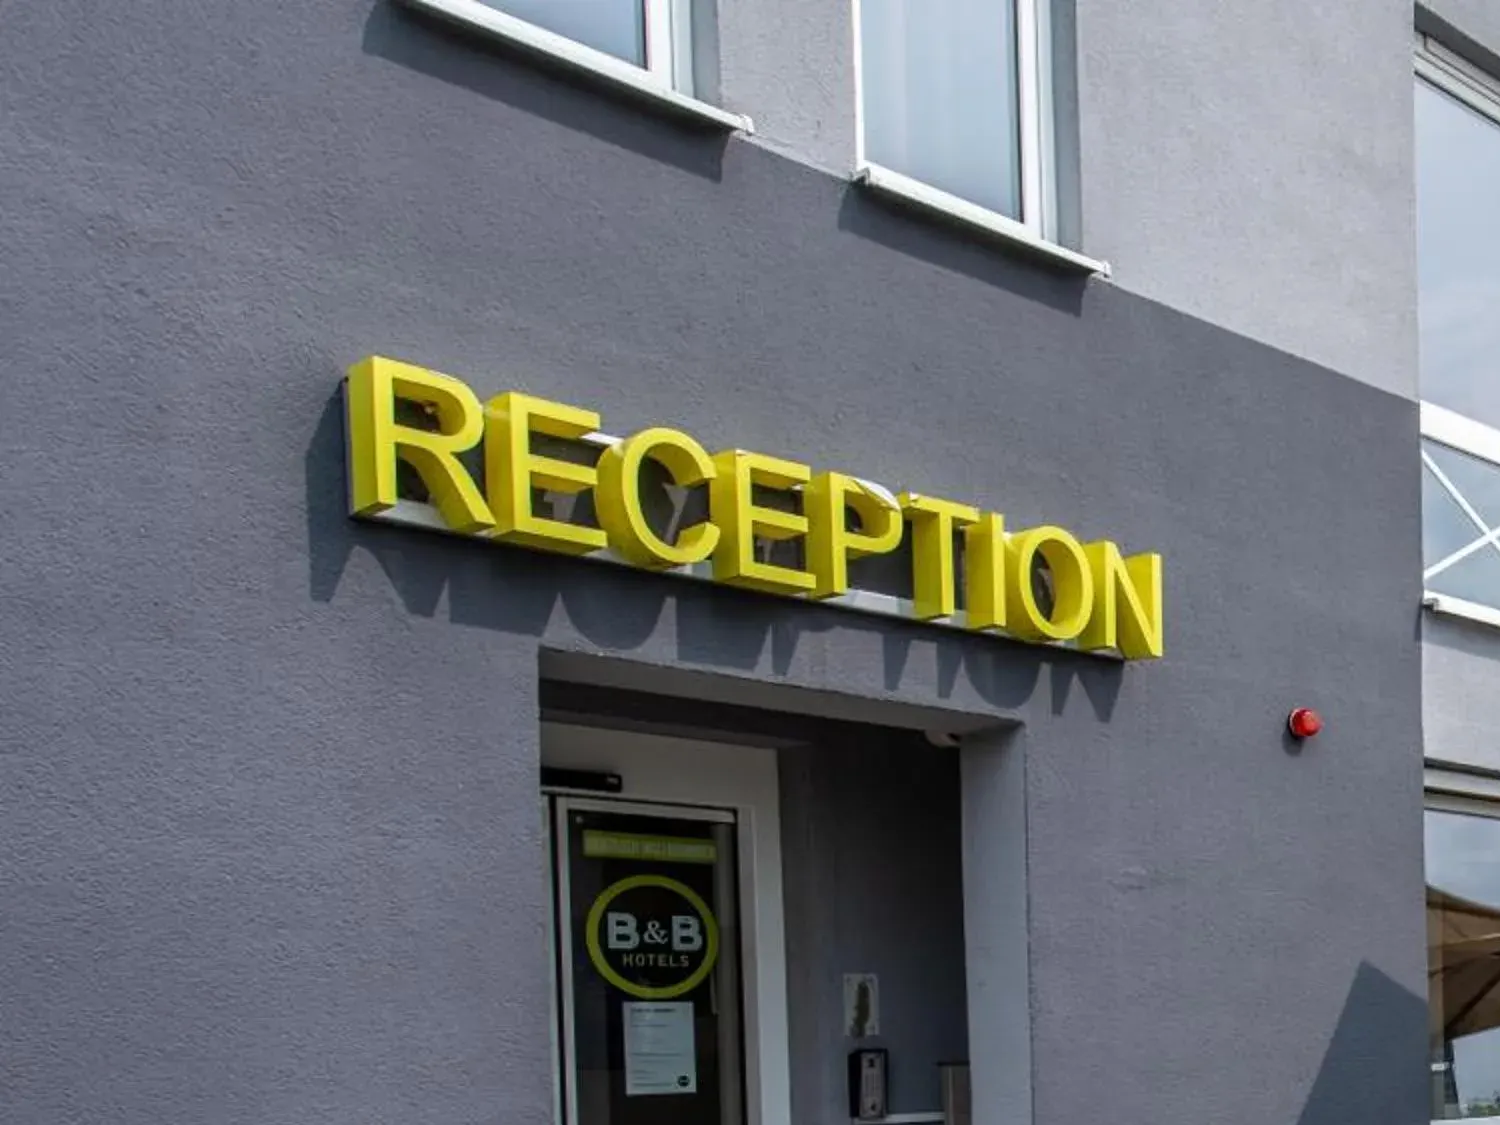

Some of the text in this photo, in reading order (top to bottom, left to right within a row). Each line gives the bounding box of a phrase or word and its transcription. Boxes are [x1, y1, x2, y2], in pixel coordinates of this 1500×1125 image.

[346, 355, 1163, 660] RECEPTION
[606, 911, 703, 952] B&B
[621, 953, 690, 968] HOTELS
